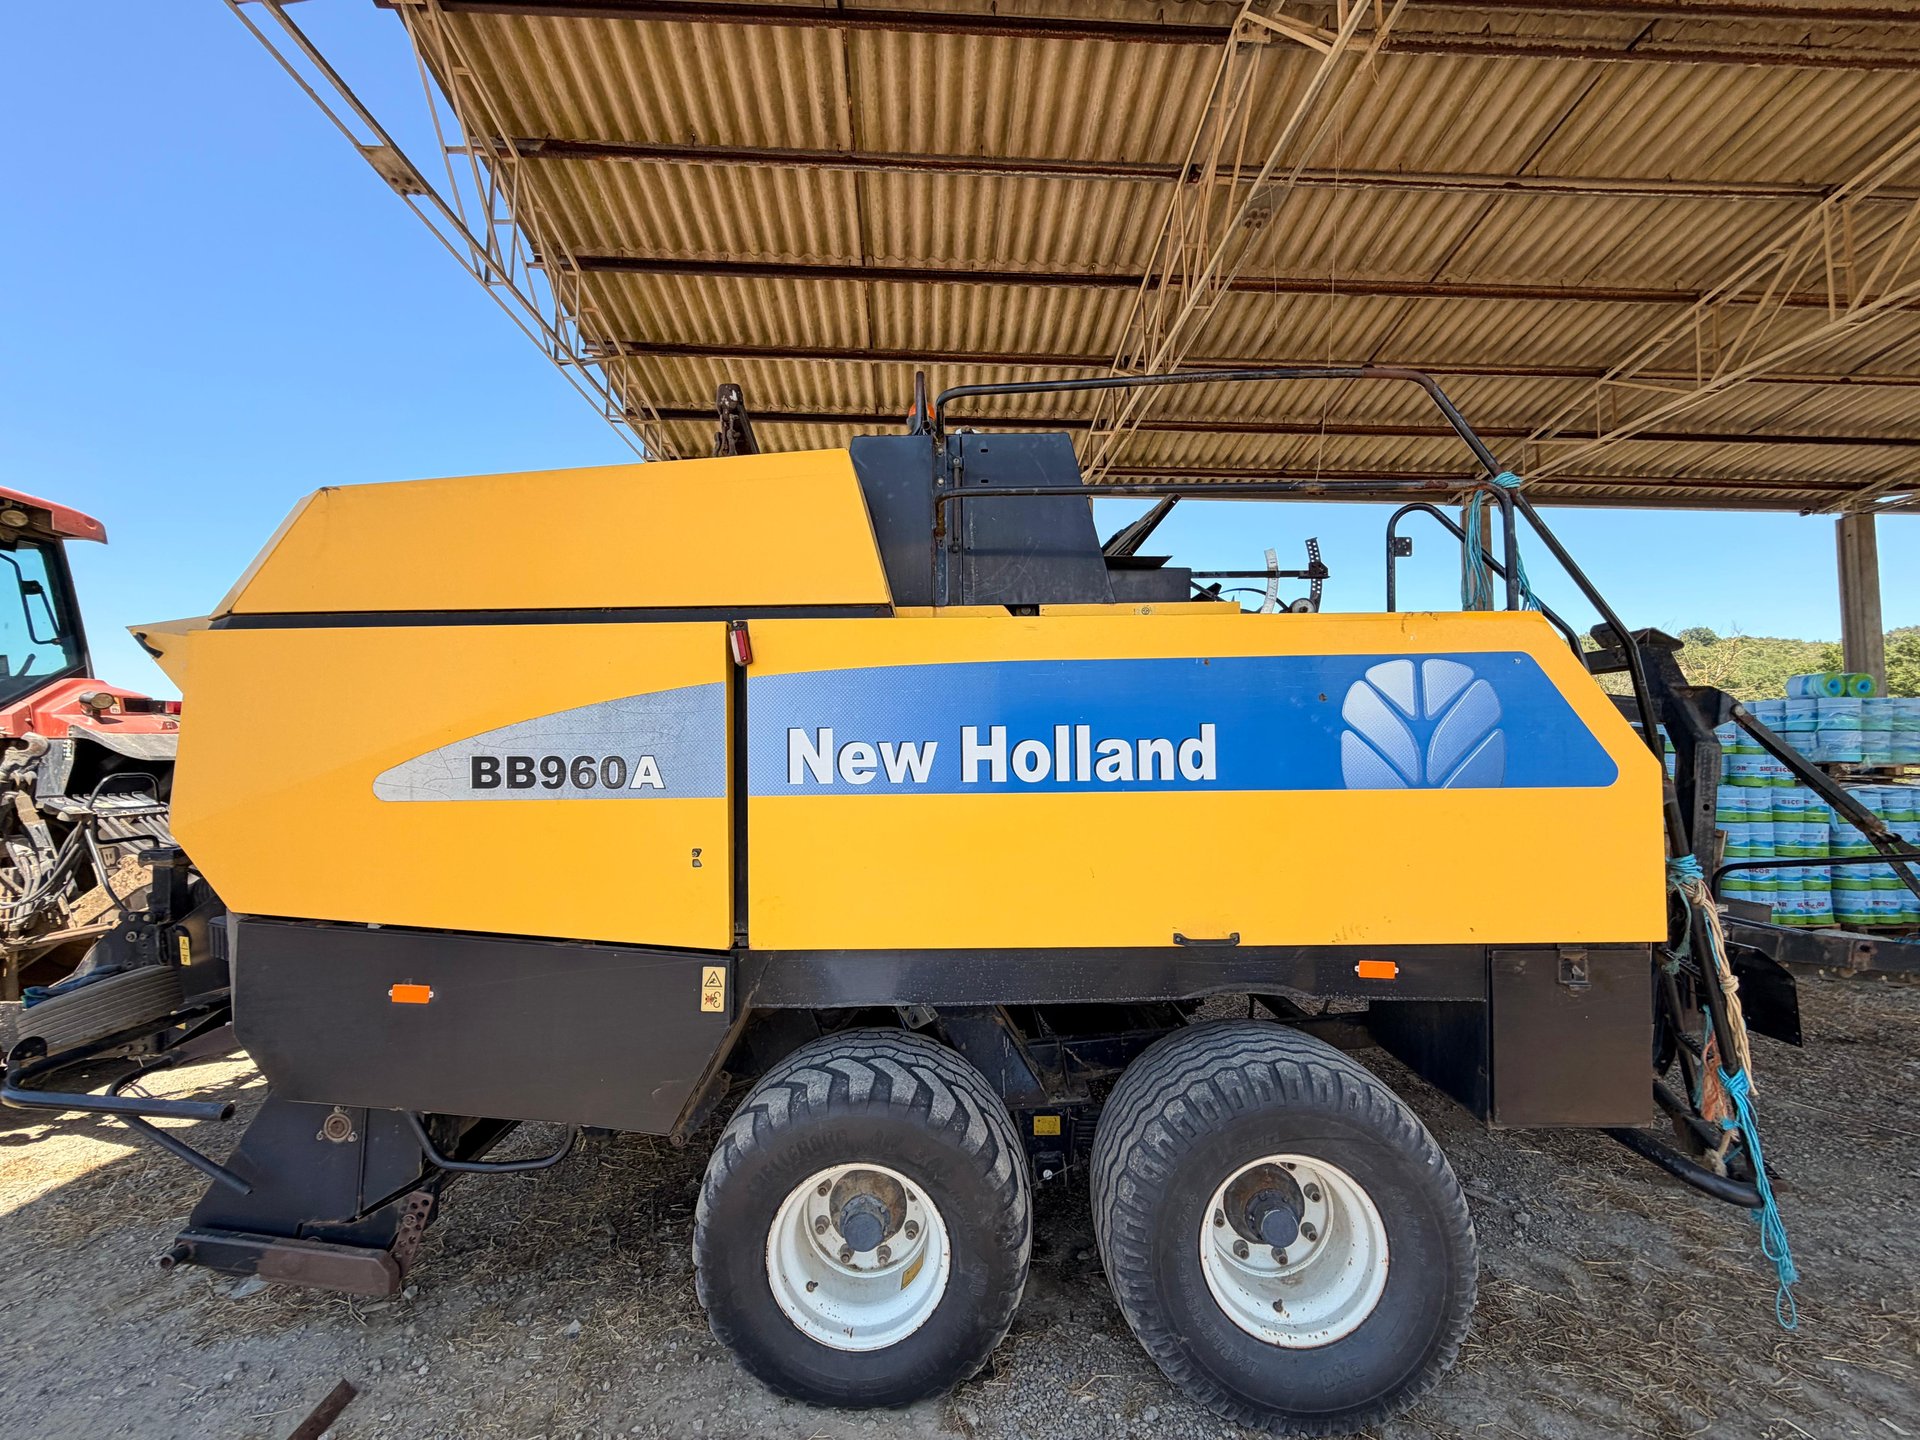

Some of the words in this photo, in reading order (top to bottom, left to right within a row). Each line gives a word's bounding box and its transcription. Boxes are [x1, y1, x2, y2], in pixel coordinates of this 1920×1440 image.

[470, 754, 666, 790] BB960A
[787, 727, 938, 785] New
[960, 723, 1217, 784] Holland
